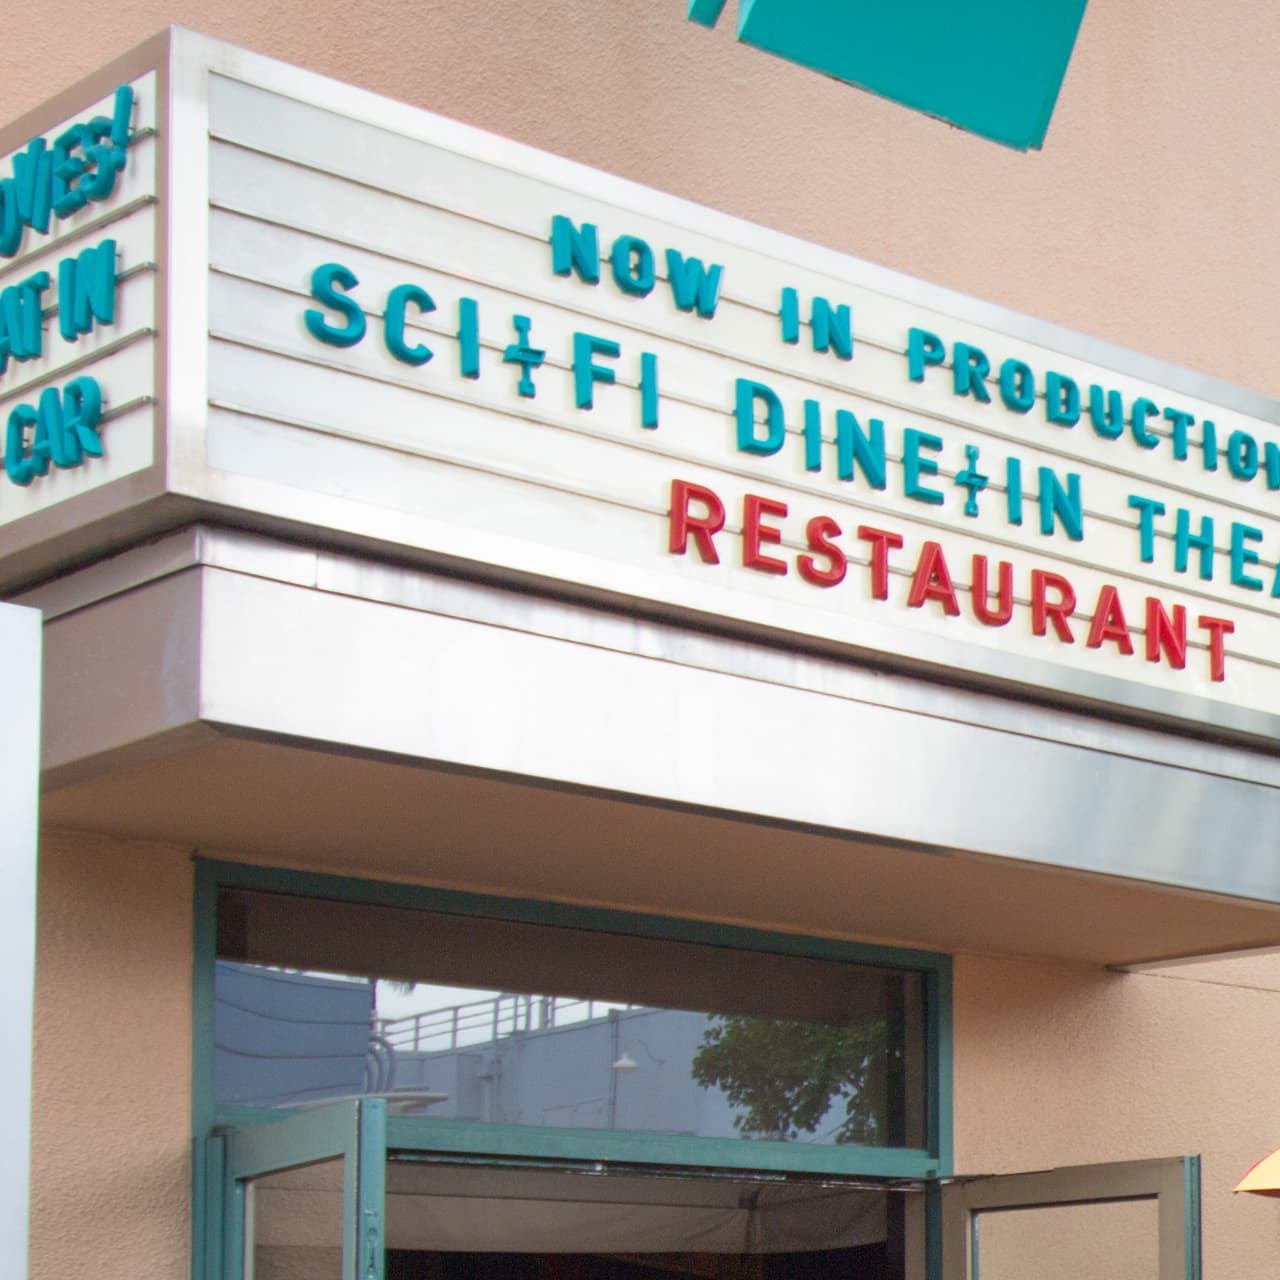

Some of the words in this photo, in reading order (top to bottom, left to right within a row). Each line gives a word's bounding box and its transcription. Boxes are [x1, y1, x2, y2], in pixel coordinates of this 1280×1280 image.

[58, 238, 116, 342] IN
[550, 214, 724, 319] NOW
[780, 287, 852, 360] IN
[5, 376, 104, 486] CAR
[305, 262, 658, 429] SCI-FI
[734, 377, 1084, 541] DINE-IN
[667, 479, 1234, 682] RESTAURANT
